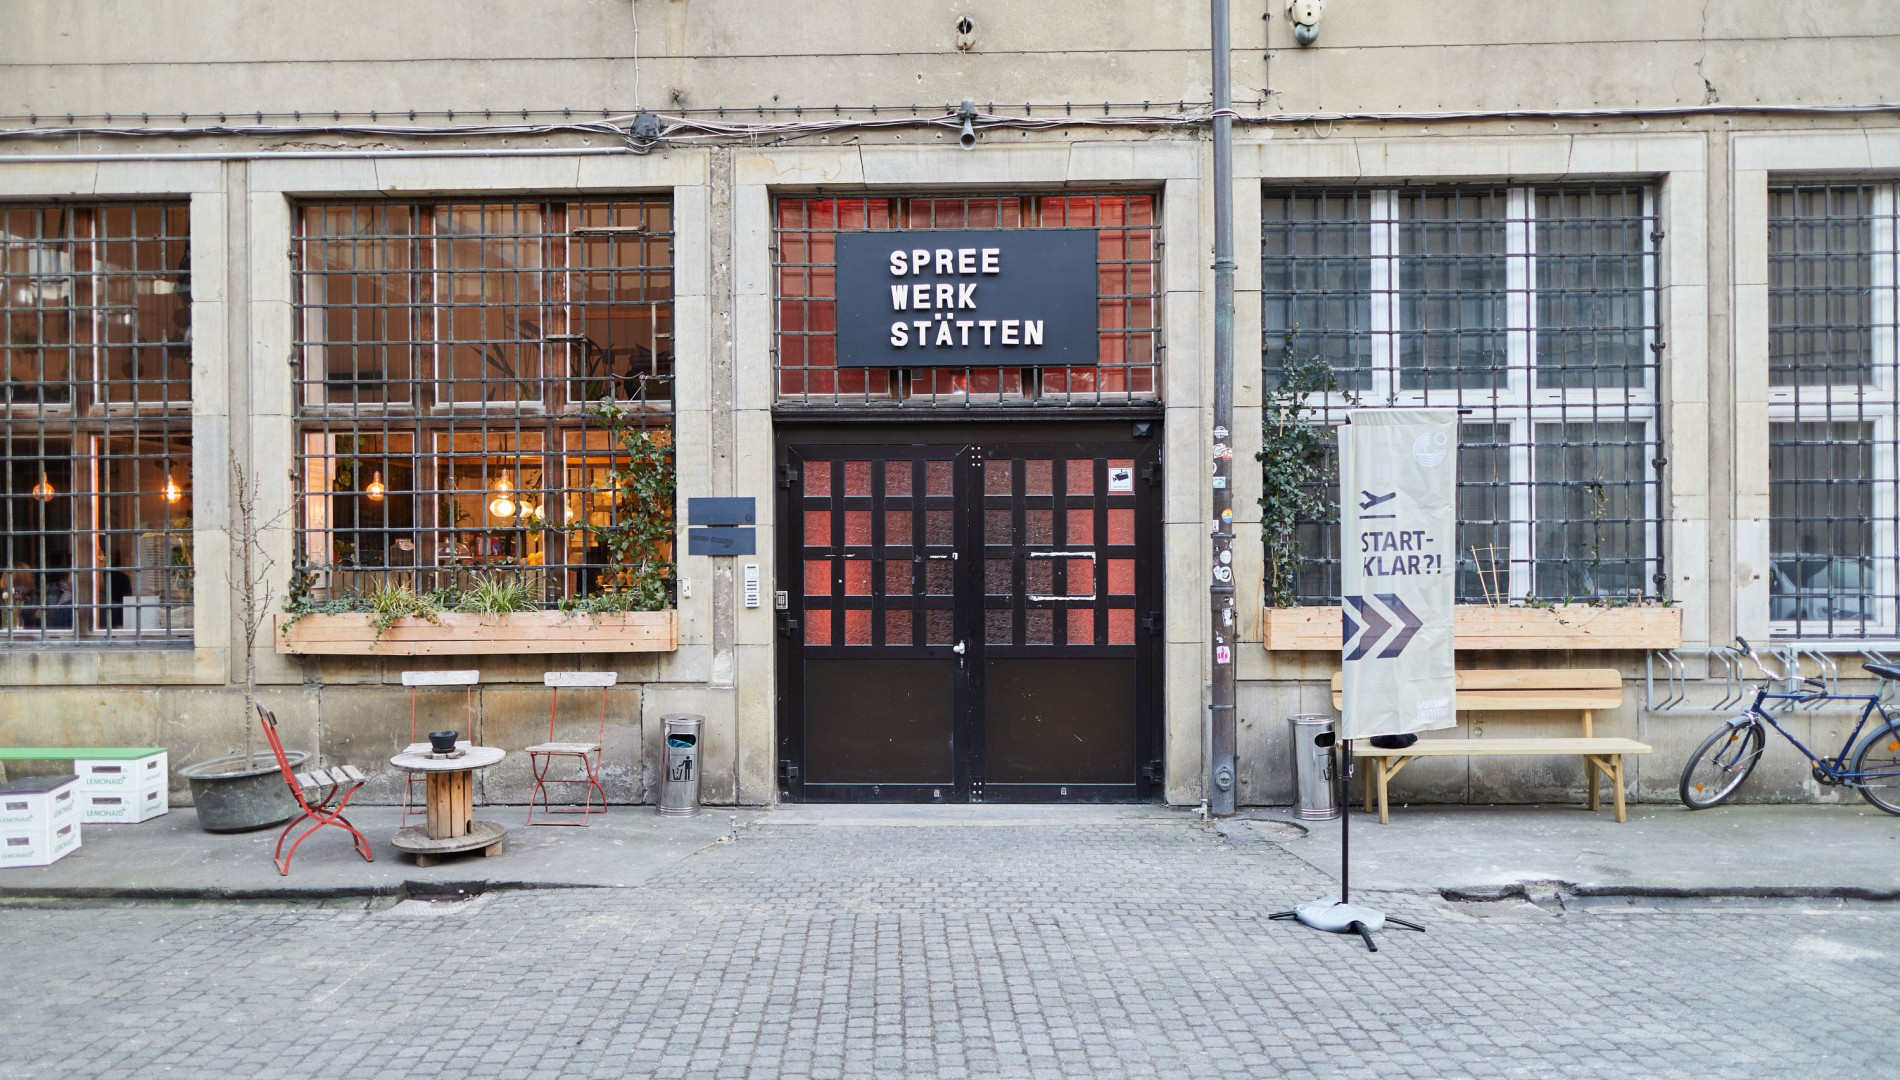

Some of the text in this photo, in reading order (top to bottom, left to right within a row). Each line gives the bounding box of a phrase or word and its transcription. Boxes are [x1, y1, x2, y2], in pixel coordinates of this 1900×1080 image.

[890, 248, 1000, 276] SPREE
[891, 283, 977, 310] WERK
[890, 313, 1044, 347] STÄTTEN
[1361, 530, 1434, 553] START-
[1363, 554, 1442, 577] KLAR?!
